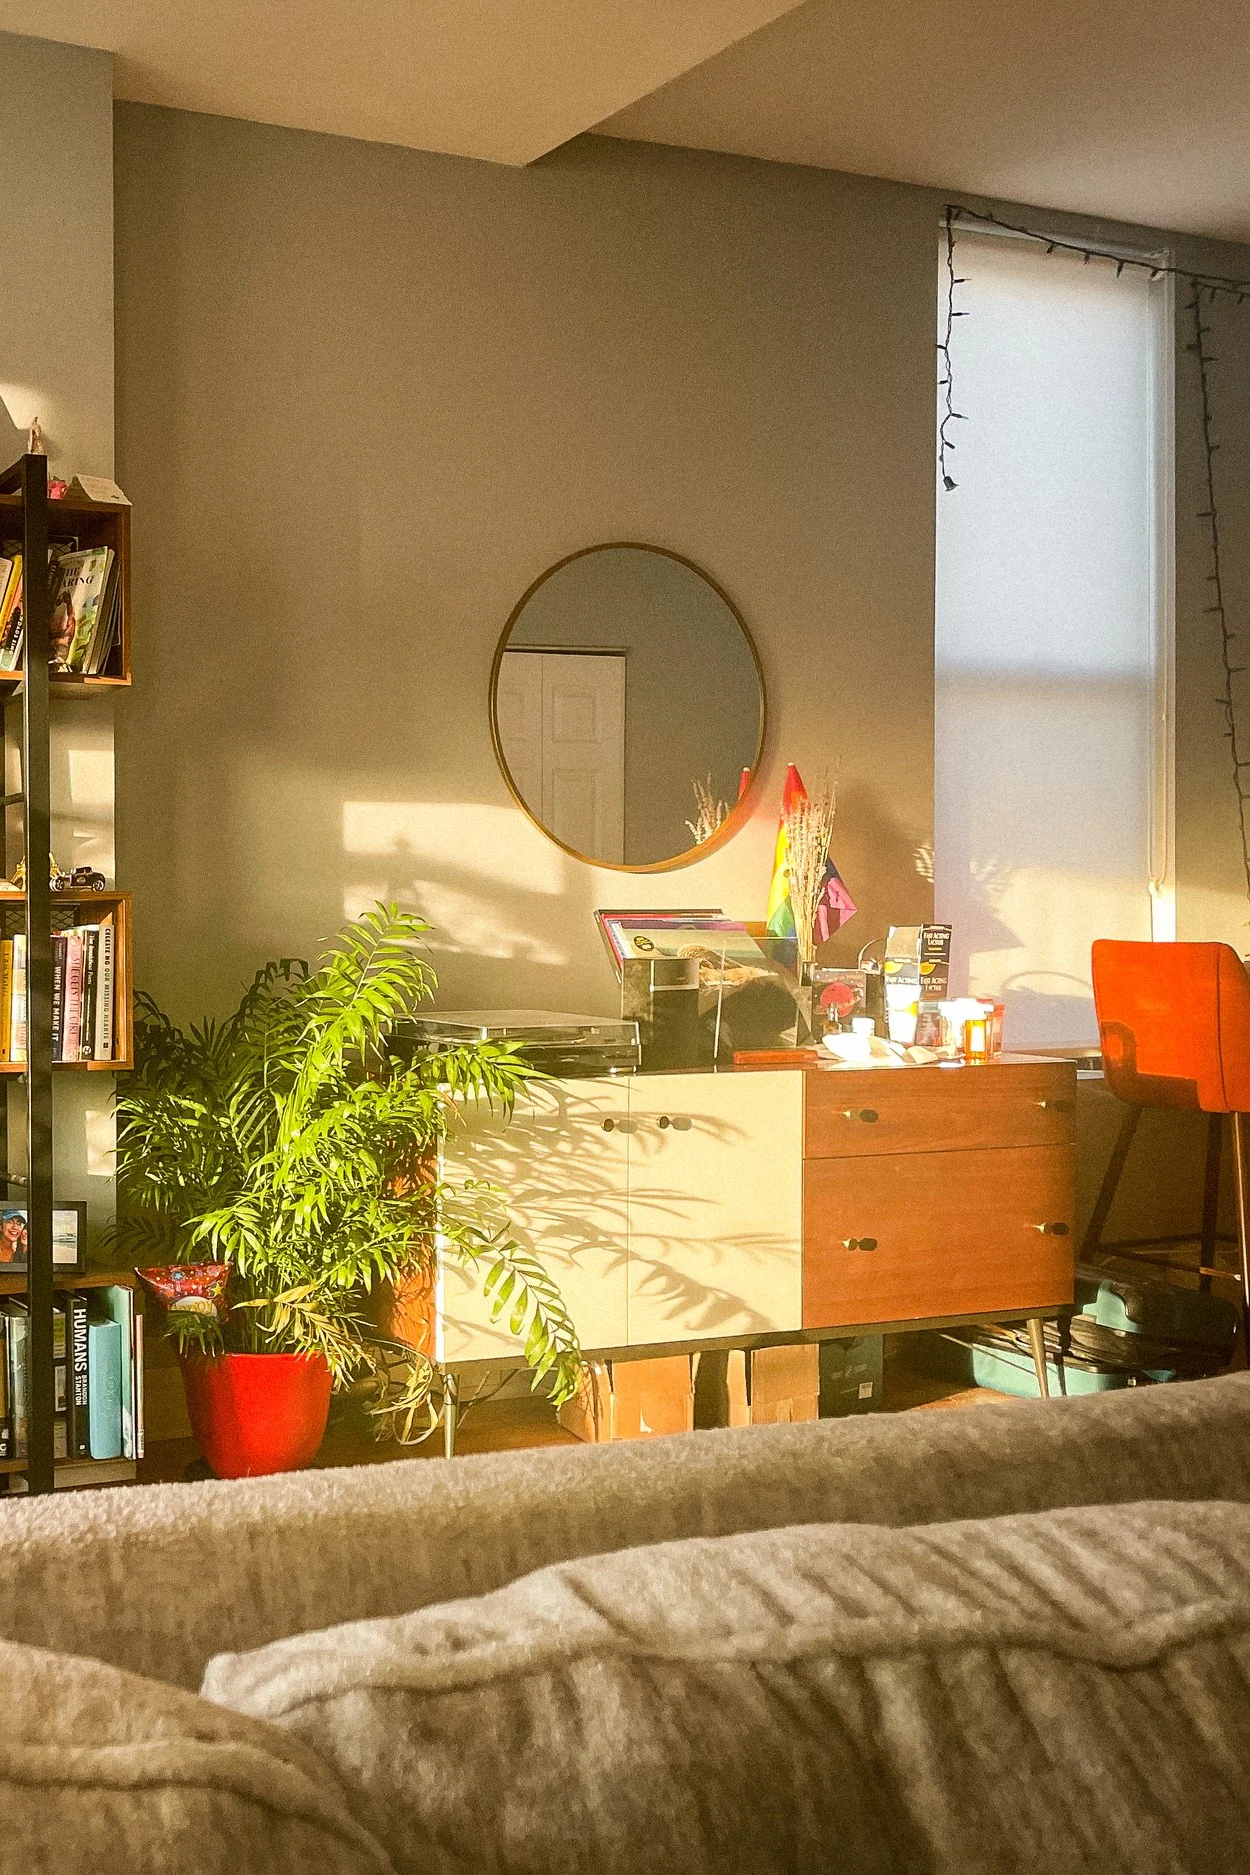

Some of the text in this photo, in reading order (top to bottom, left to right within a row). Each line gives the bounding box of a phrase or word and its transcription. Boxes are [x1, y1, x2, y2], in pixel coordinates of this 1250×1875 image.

[103, 927, 111, 953] CELESTE
[104, 955, 110, 965] NG
[53, 965, 61, 990] WHEN
[52, 992, 60, 1006] WE
[51, 1007, 60, 1031] MAKE
[51, 1032, 58, 1041] IT
[73, 1308, 87, 1372] HUMANS
